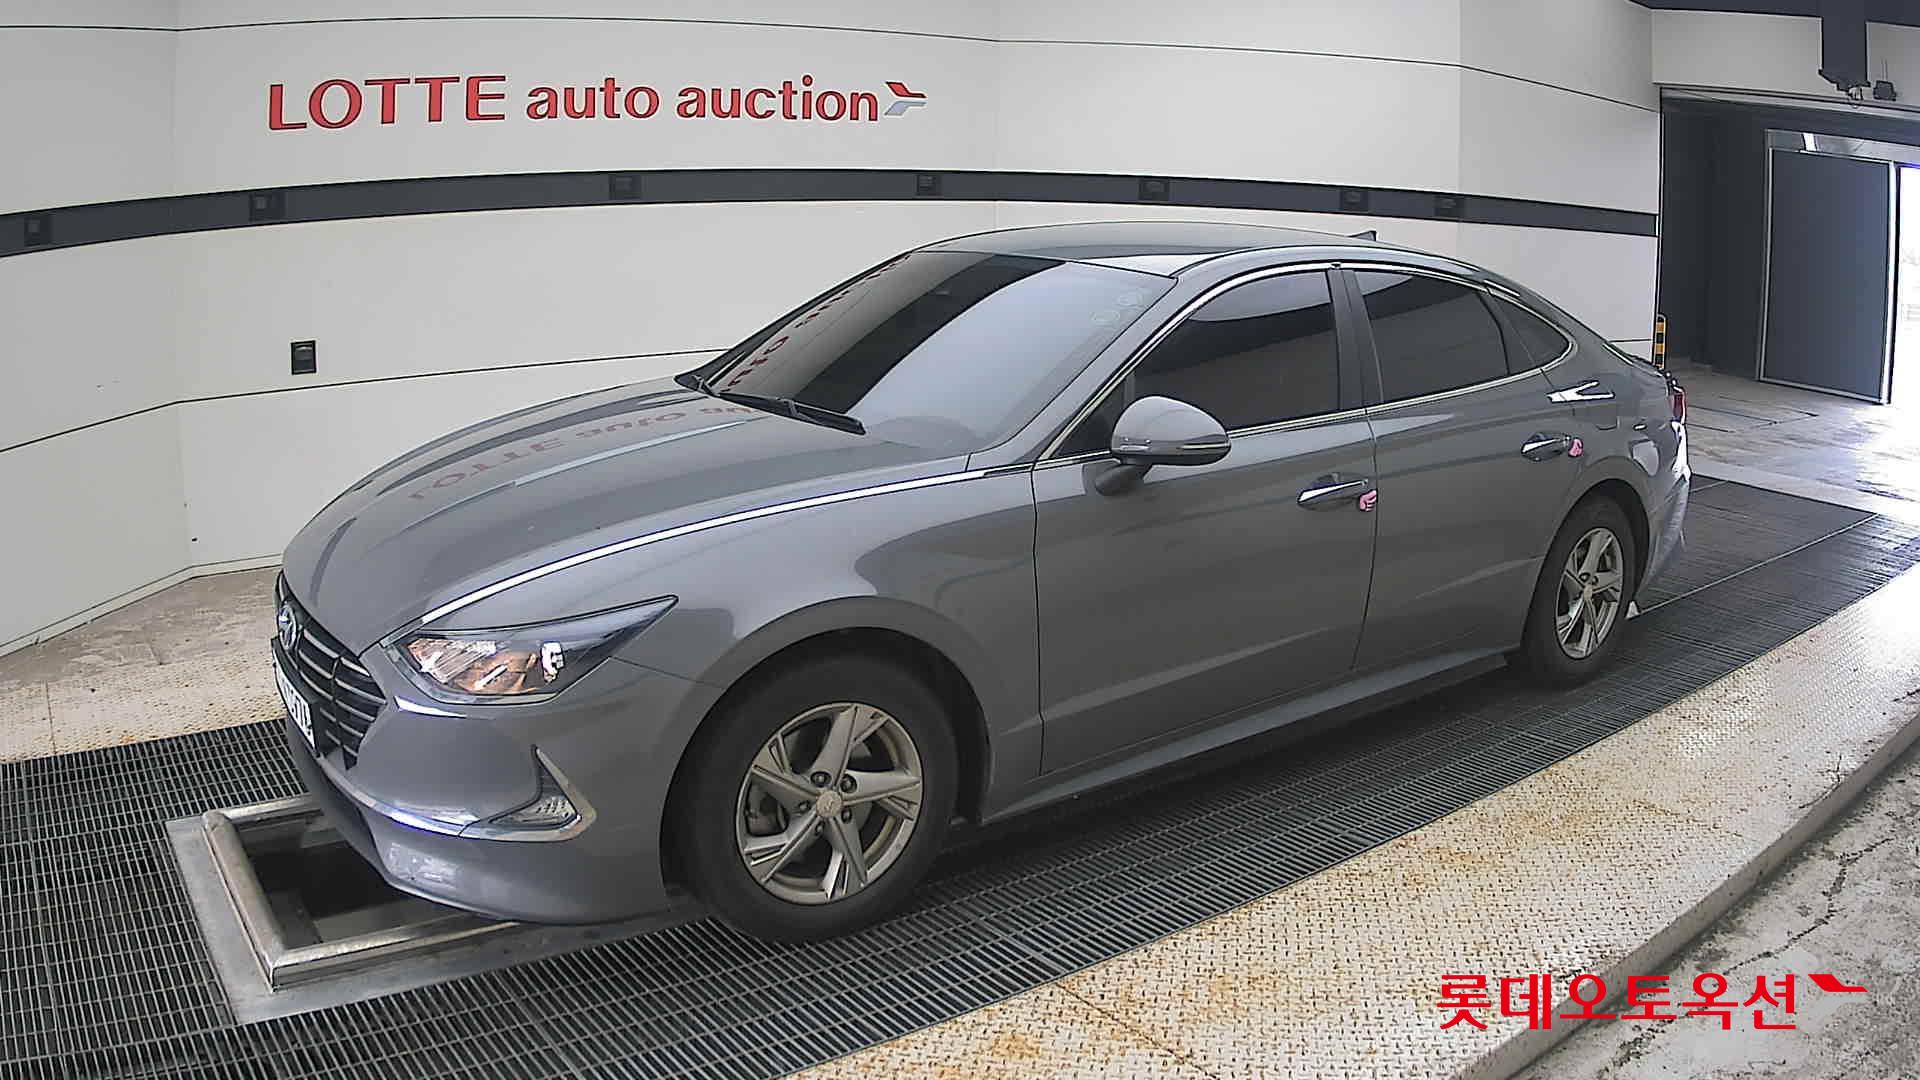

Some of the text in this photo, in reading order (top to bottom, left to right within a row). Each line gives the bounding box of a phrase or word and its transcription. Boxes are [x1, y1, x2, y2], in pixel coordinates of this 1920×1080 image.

[268, 75, 878, 130] LOTTE auto auction
